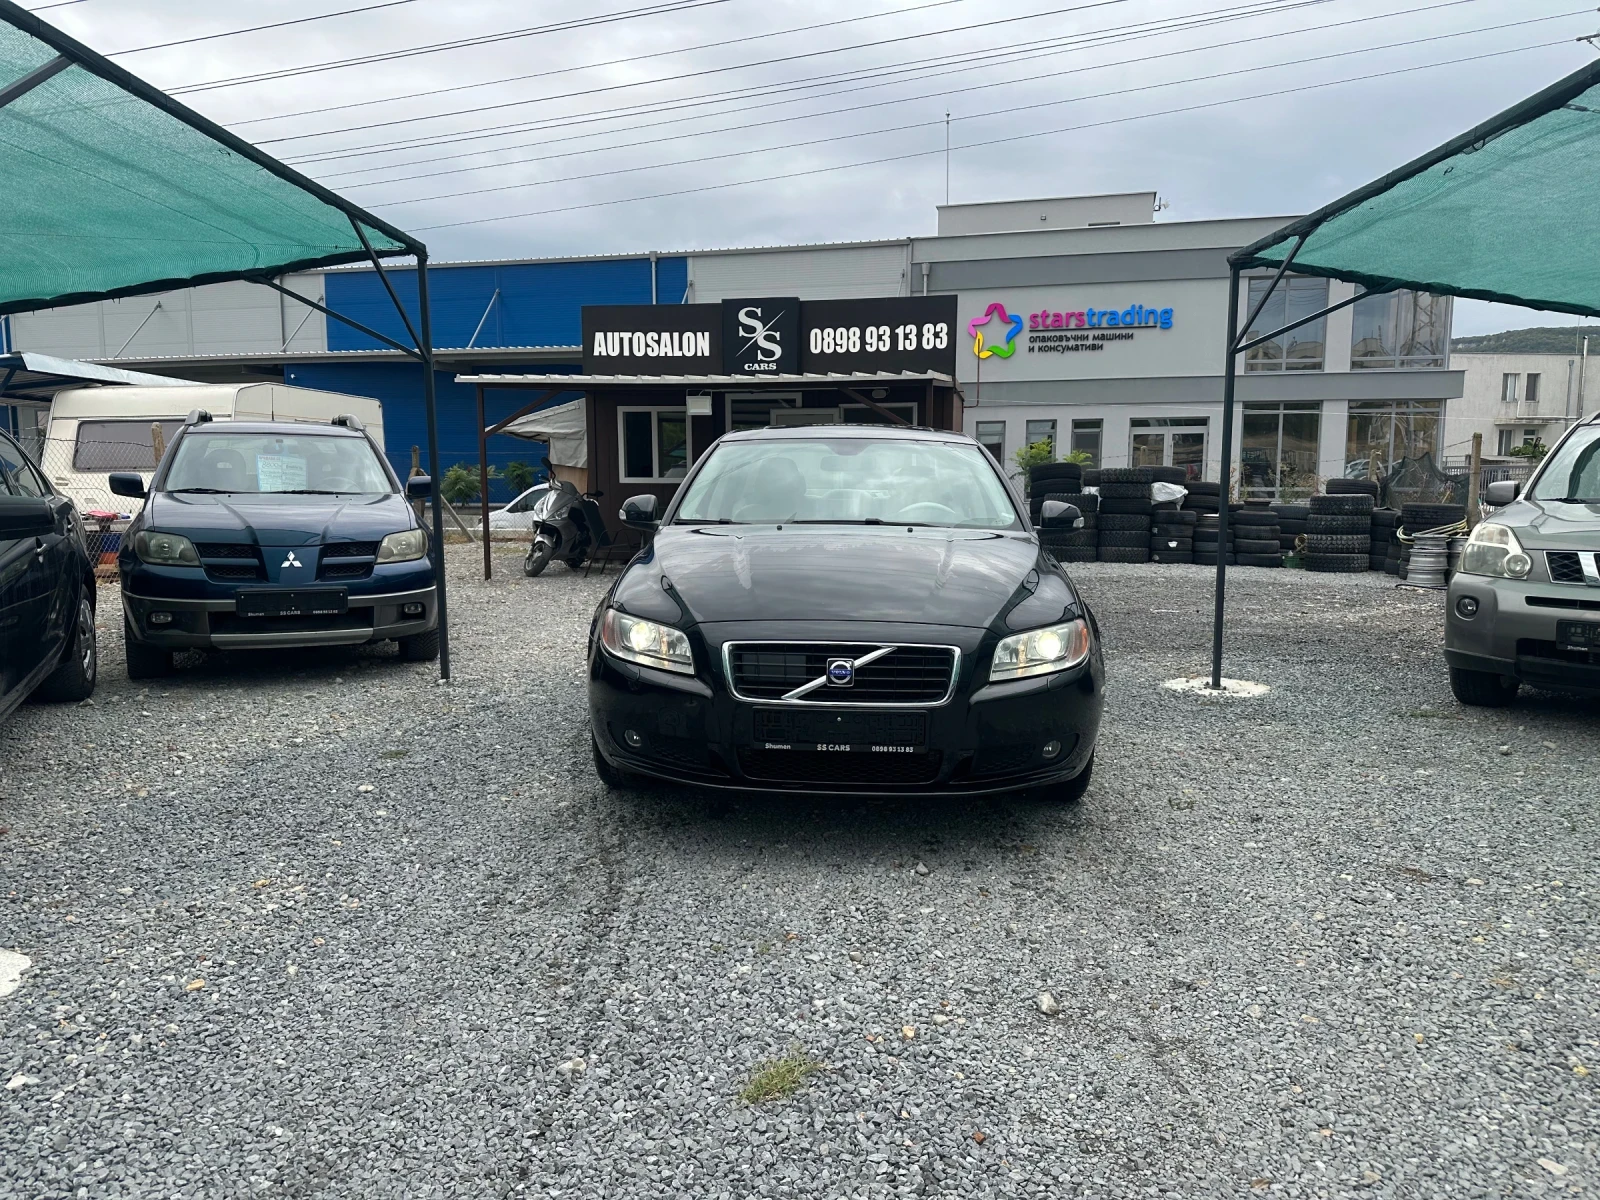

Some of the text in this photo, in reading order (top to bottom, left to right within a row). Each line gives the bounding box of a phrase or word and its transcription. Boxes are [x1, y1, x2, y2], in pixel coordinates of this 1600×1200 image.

[1029, 304, 1174, 329] starstrading
[809, 322, 949, 354] 0898 93 13 83
[1029, 332, 1134, 343] опаковъчни машини
[593, 331, 710, 357] AUTOSALON
[1028, 343, 1104, 354] и консумативи
[743, 362, 777, 371] CARS
[765, 742, 791, 750] Shumen
[816, 743, 827, 751] SS
[828, 743, 850, 751] CARS
